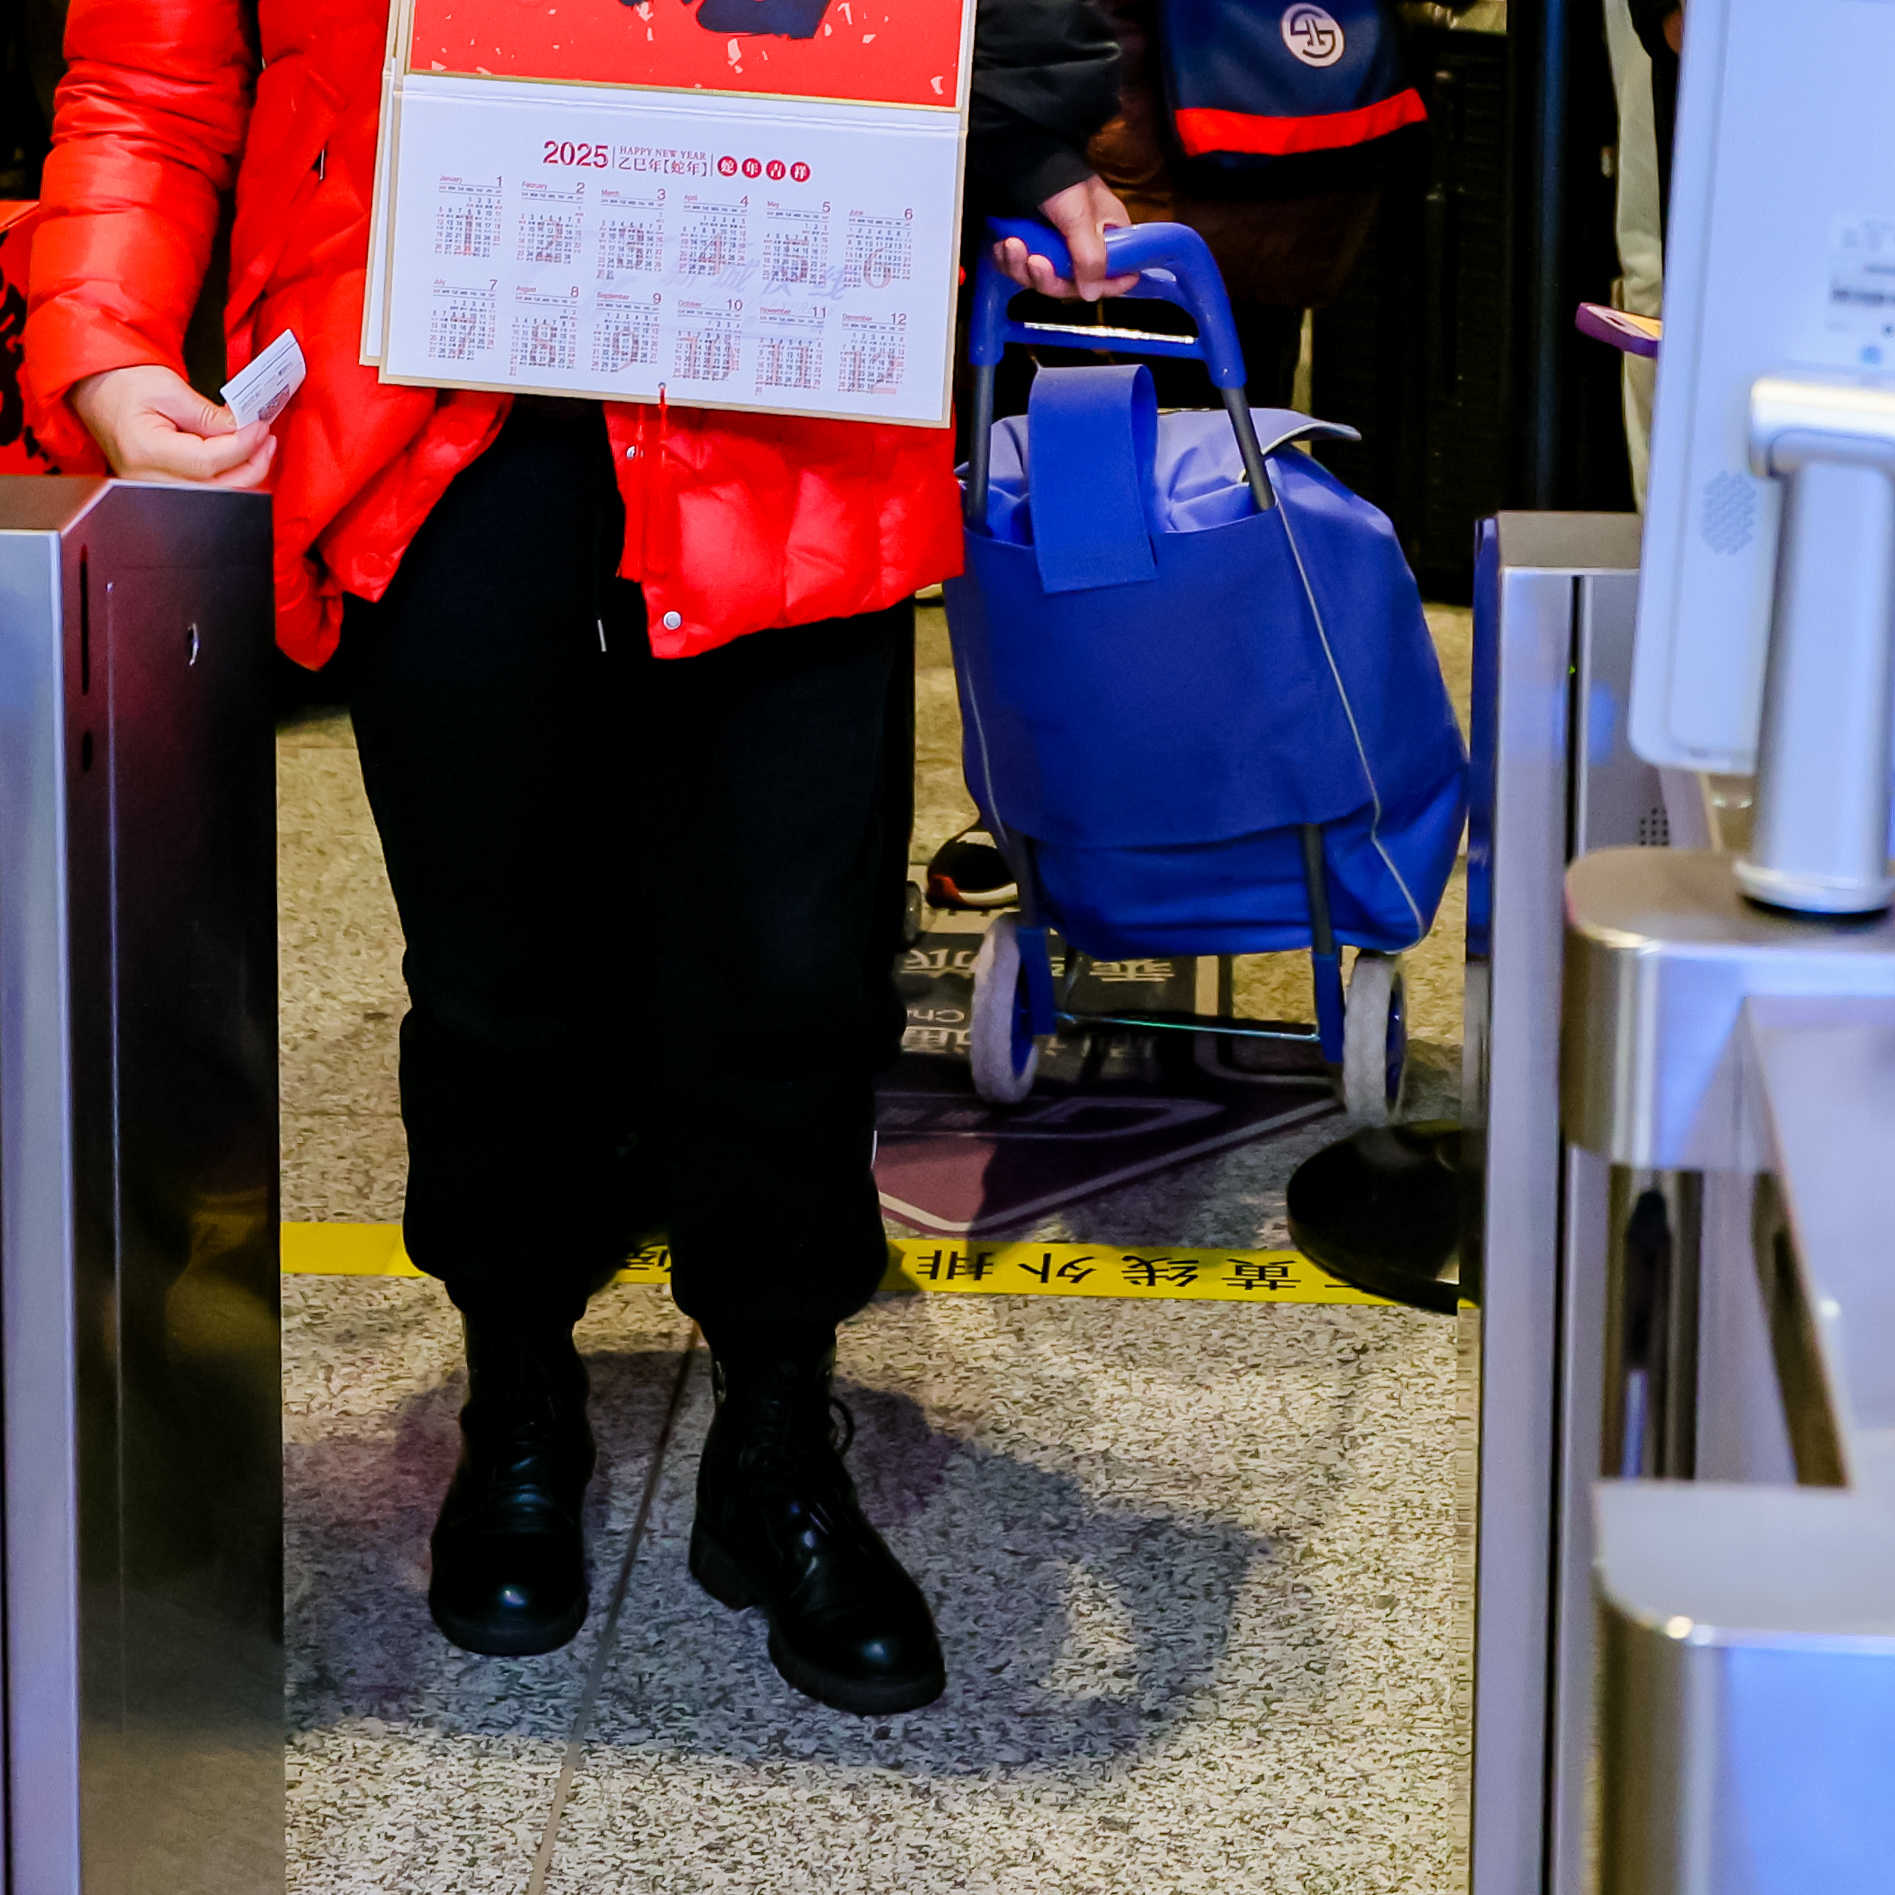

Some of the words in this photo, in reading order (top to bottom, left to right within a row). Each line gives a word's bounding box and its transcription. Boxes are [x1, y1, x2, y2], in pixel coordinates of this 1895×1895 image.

[543, 140, 609, 169] 2025
[618, 145, 652, 157] HAPPY
[655, 148, 677, 159] NEW
[680, 150, 707, 161] YEAR
[496, 175, 503, 187] 1
[576, 182, 585, 194] 2
[657, 188, 666, 200] 3
[739, 195, 749, 207] 4
[822, 201, 831, 214] 5
[904, 208, 913, 220] 6
[489, 279, 498, 291] 7
[569, 286, 579, 298] 8
[652, 292, 662, 304] 9
[726, 298, 743, 311] 10
[811, 306, 827, 318] 11
[890, 312, 907, 325] 12
